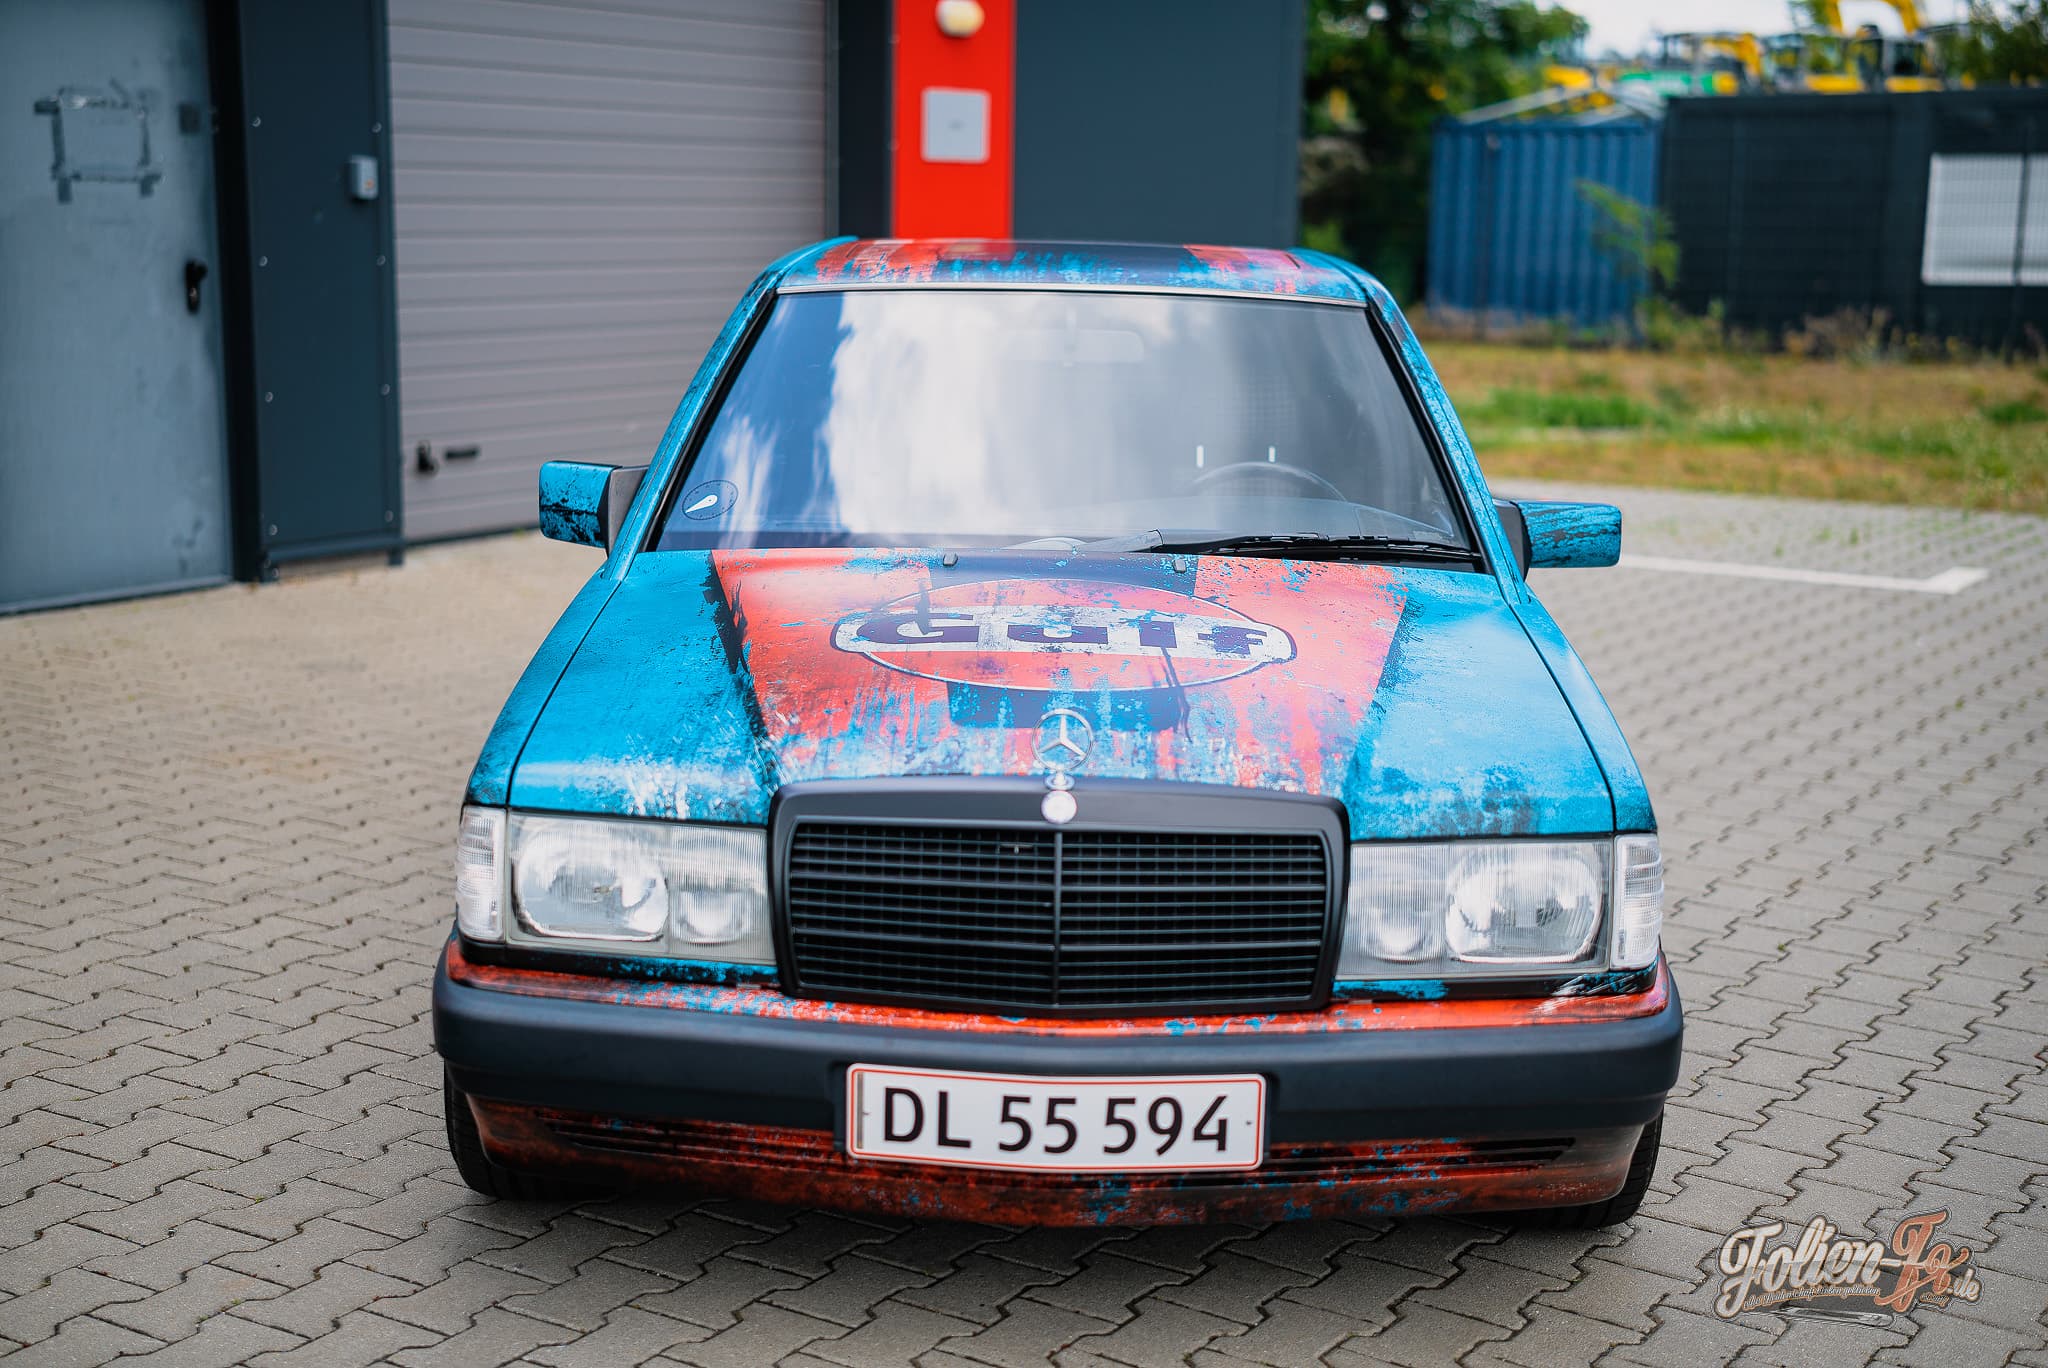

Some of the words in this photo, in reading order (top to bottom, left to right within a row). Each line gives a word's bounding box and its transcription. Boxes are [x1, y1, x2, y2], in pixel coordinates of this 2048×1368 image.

[883, 1086, 972, 1149] DL
[998, 1095, 1078, 1154] 55
[1102, 1095, 1228, 1157] 594
